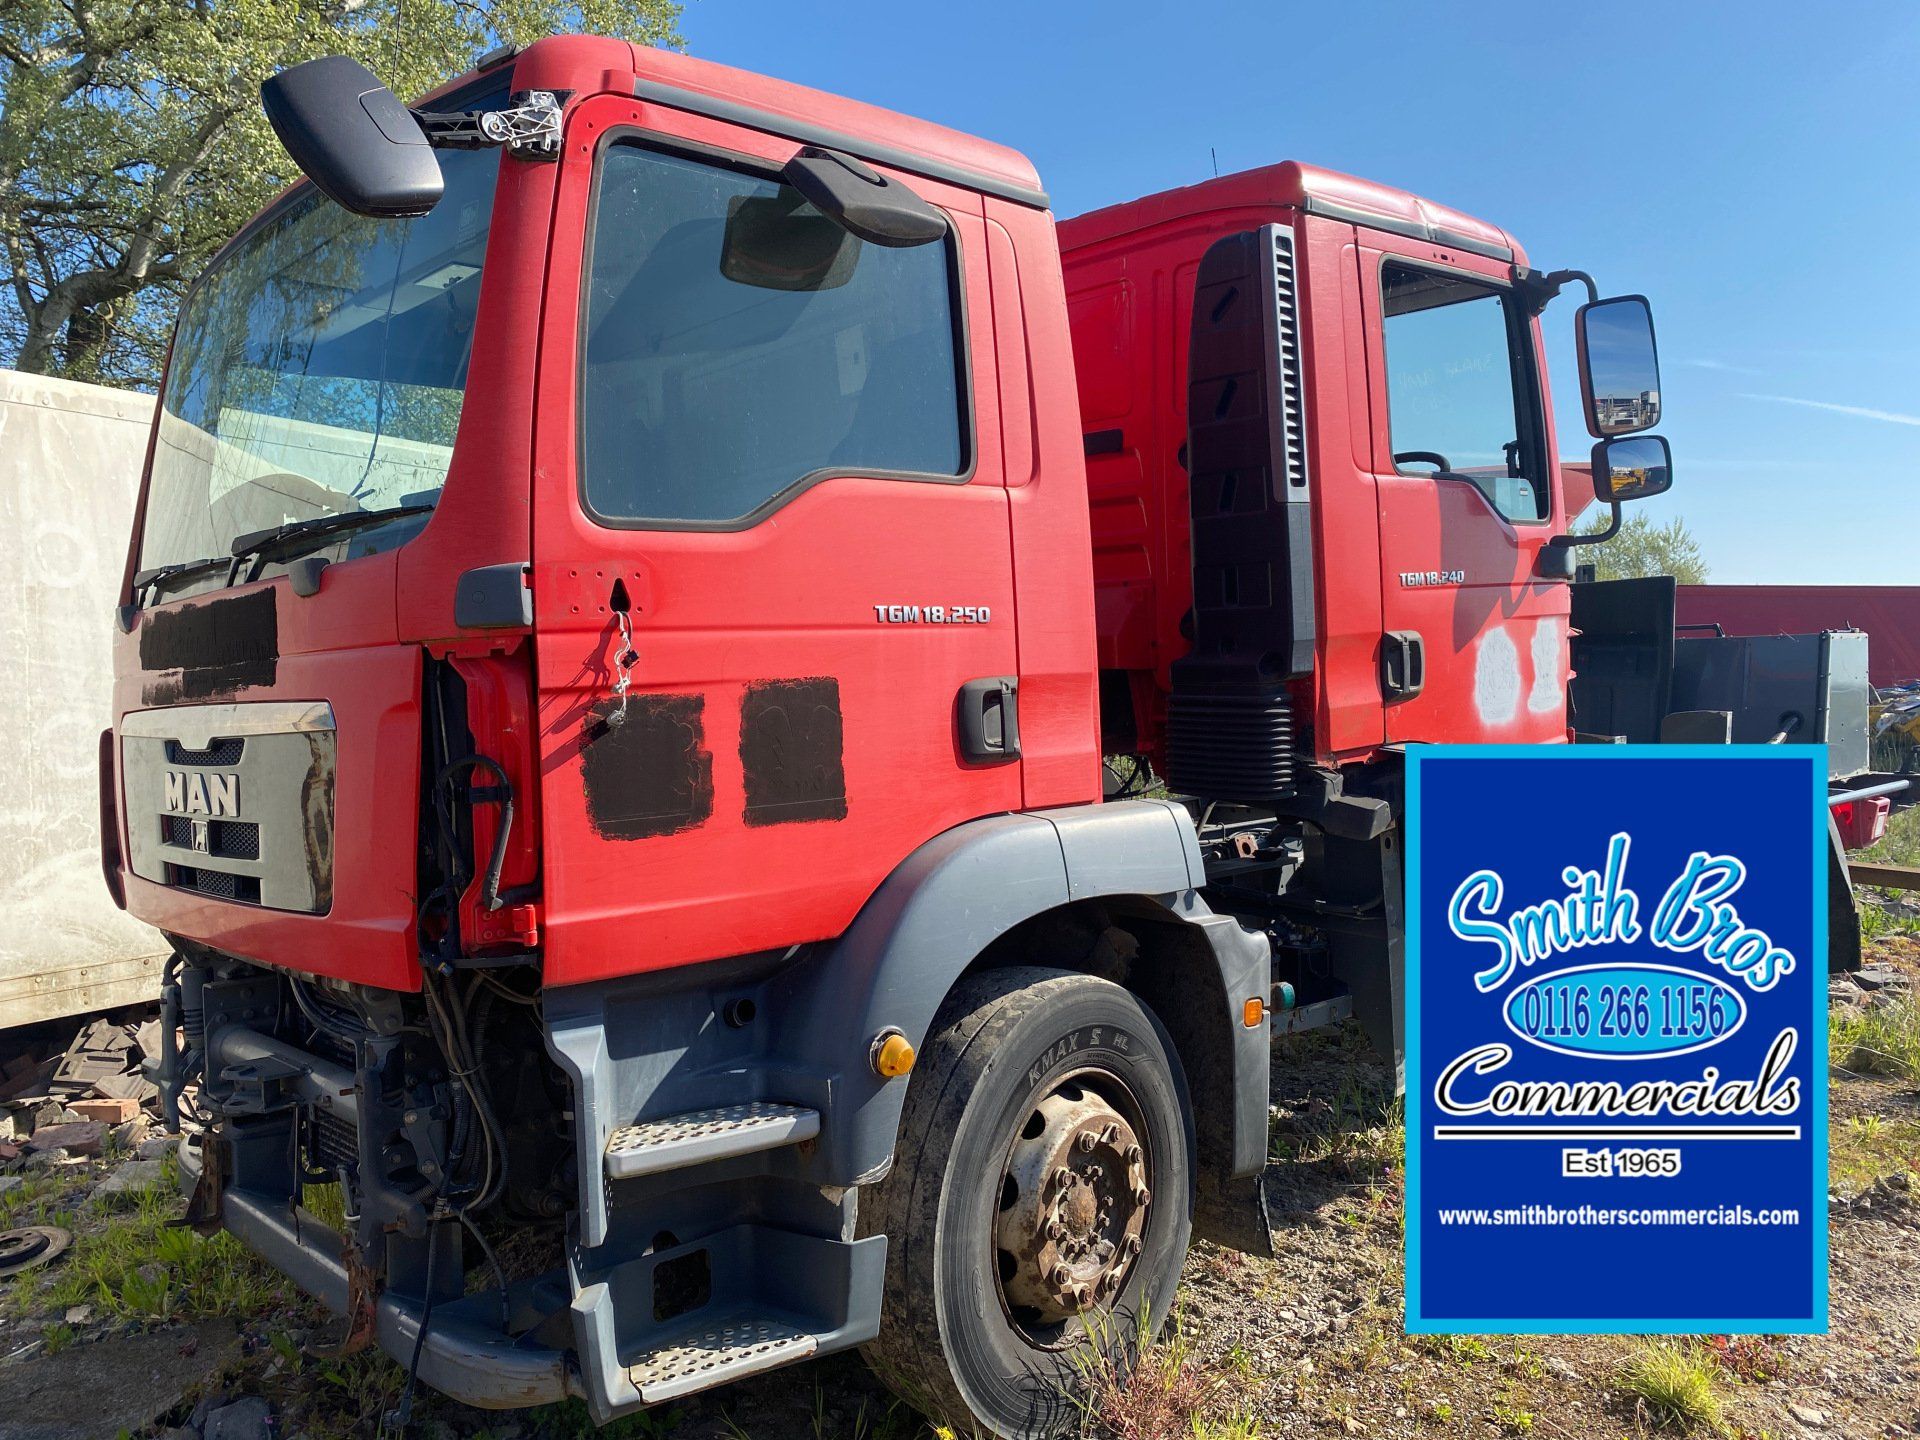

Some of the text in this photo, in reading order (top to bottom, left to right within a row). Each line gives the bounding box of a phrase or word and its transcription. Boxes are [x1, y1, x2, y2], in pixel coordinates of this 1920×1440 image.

[1399, 570, 1465, 587] TGM 18.240
[873, 605, 991, 624] TGM 18.250
[165, 771, 241, 817] MAN
[1028, 1032, 1080, 1088] KMAX
[1090, 1027, 1102, 1046] S
